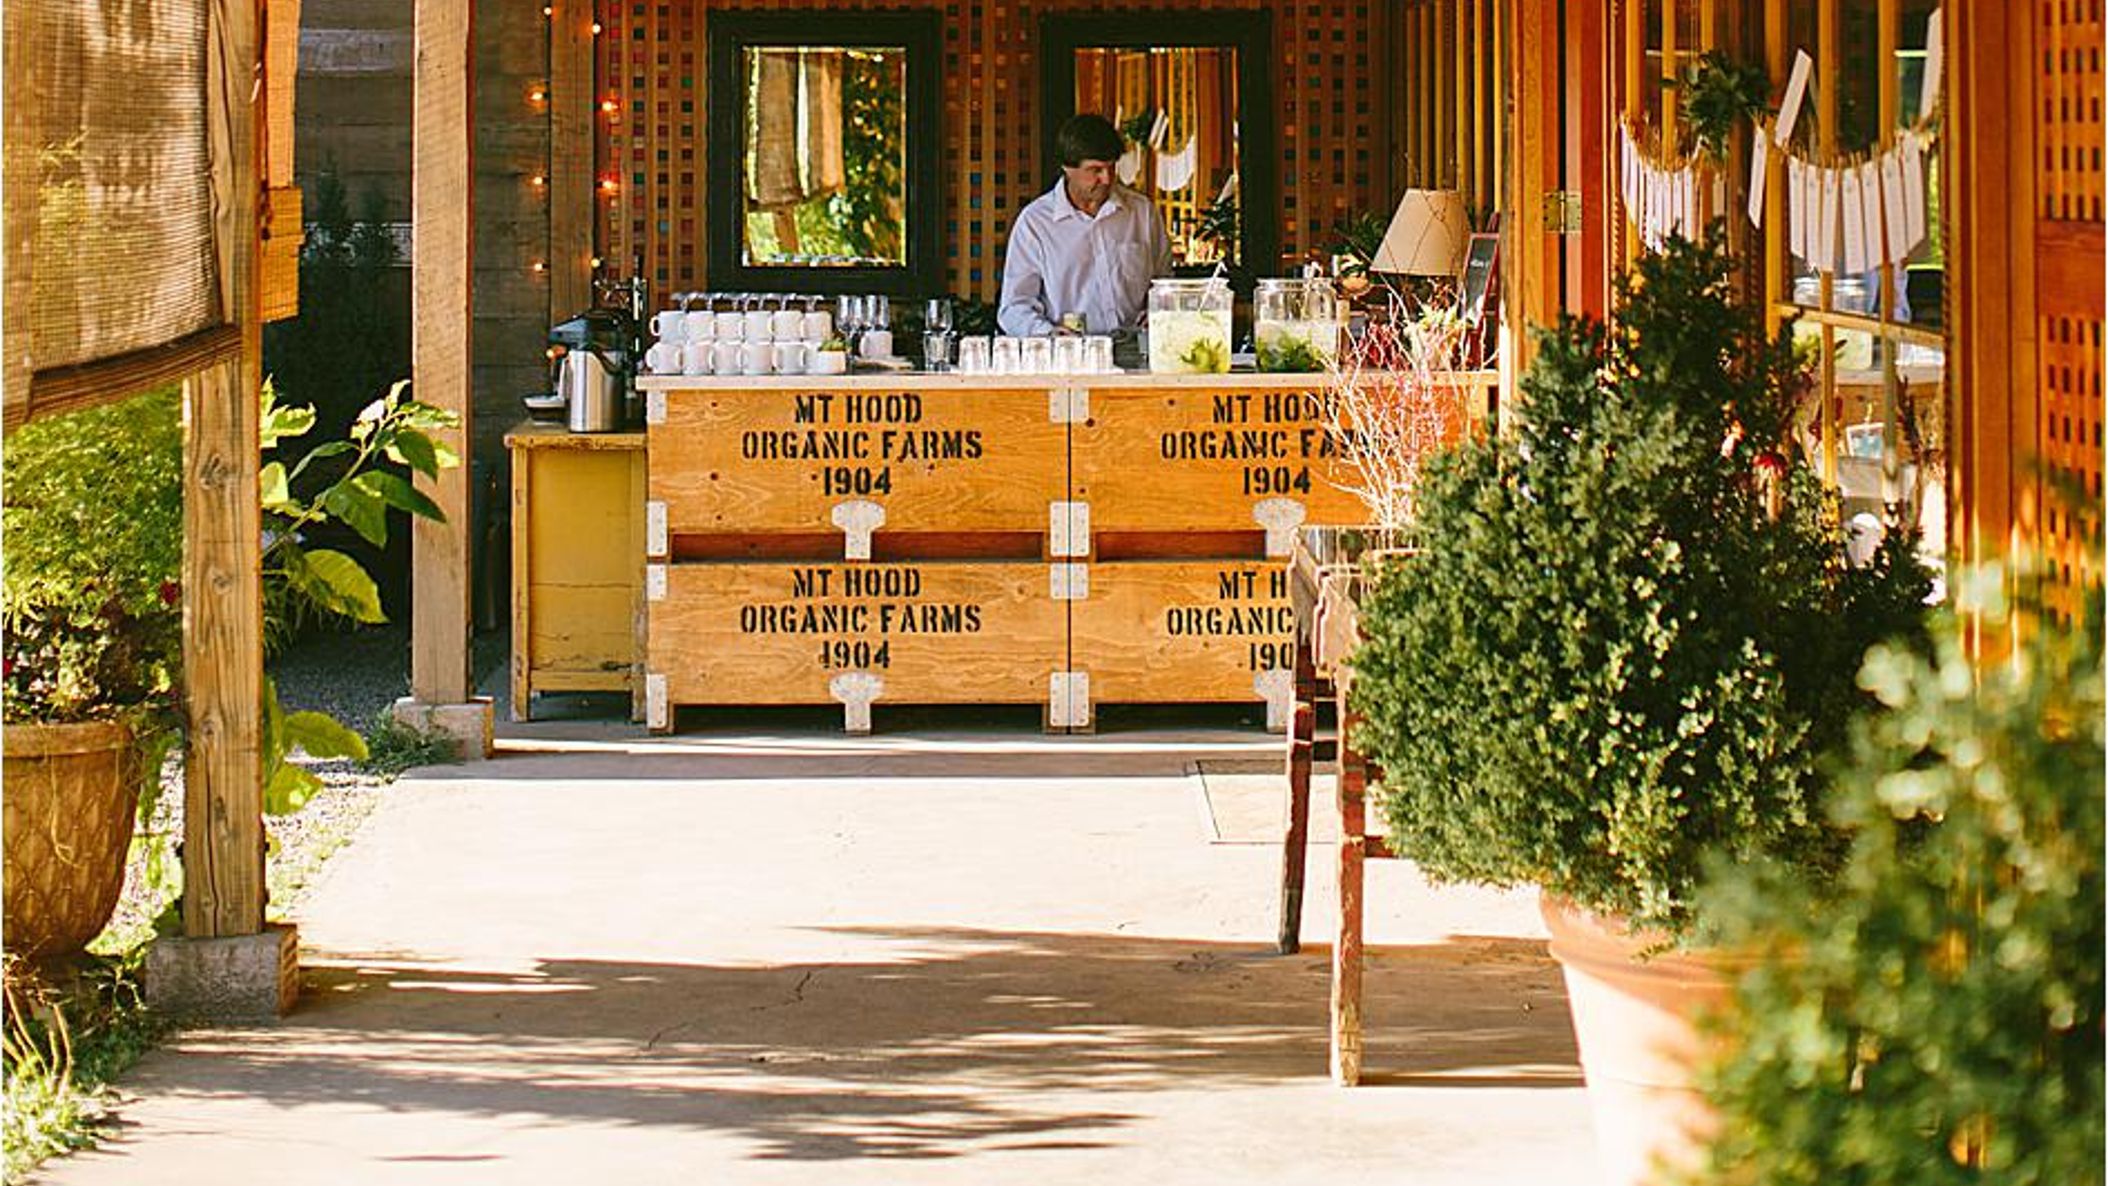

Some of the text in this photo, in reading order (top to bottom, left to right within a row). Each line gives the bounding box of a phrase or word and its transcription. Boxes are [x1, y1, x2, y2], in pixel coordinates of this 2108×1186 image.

[795, 394, 922, 424] MT HOOD
[1213, 395, 1253, 423] MT
[742, 430, 983, 459] ORGANIC FARMS
[1161, 431, 1287, 459] ORGANIC
[824, 466, 892, 496] 1904
[1244, 466, 1311, 495] 1904
[793, 568, 920, 598] MT HOOD
[1219, 571, 1257, 600] MT
[741, 604, 980, 633] ORGANIC FARMS
[1167, 607, 1293, 635] ORGANIC
[822, 640, 890, 669] 1904
